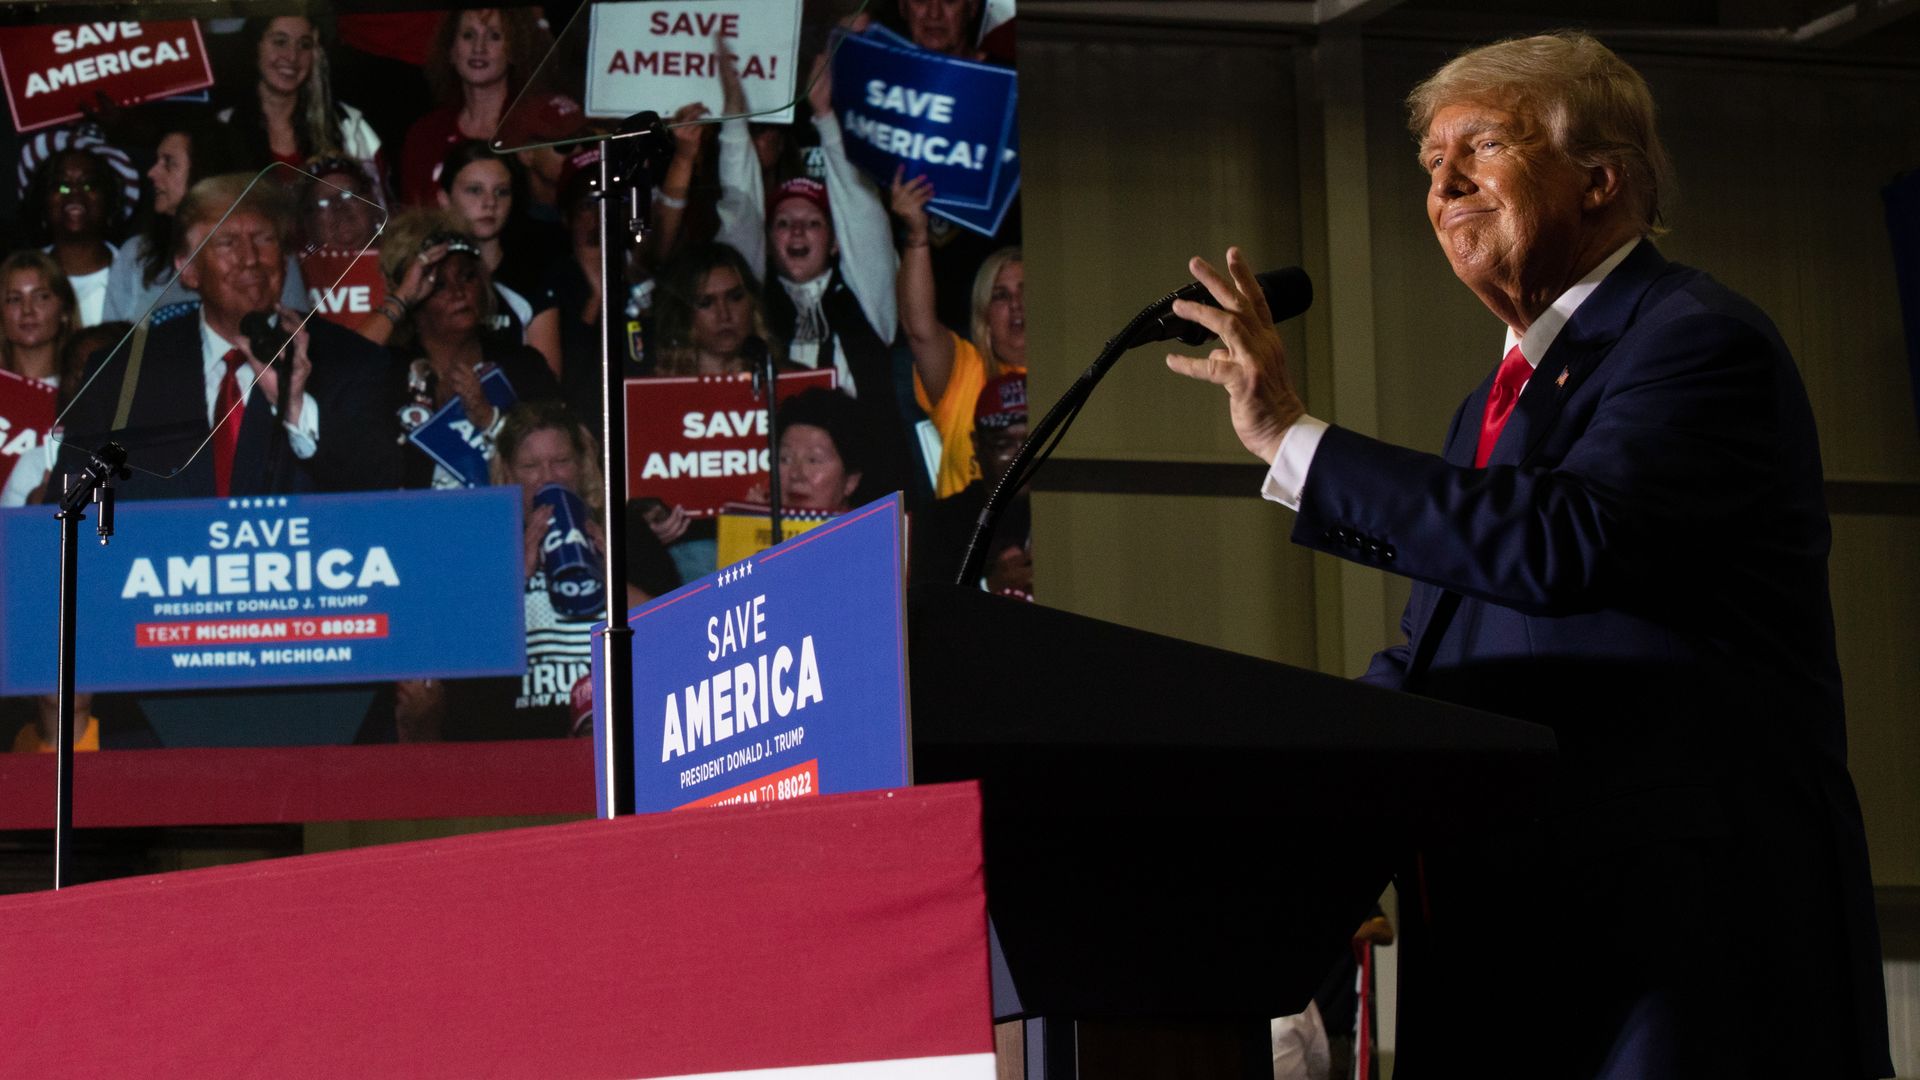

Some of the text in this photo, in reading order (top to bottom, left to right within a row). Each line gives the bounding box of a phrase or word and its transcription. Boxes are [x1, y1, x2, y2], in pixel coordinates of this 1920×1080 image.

[52, 21, 143, 54] SAVE
[650, 11, 740, 38] SAVE
[25, 37, 190, 98] AMERICA!
[866, 79, 955, 123] SAVE
[309, 286, 371, 314] AVE
[209, 517, 310, 549] SAVE
[121, 546, 400, 599] AMERICA
[153, 594, 369, 616] PRESIDENT DONALD J. TRUMP
[146, 618, 377, 642] TEXT MICHIGAN TO 88022
[707, 594, 767, 662] SAVE
[171, 646, 353, 668] WARREN, MICHIGAN
[661, 635, 824, 763] AMERICA
[680, 726, 805, 790] PRESIDENT DONALD J. TRUMP
[760, 784, 775, 802] TO
[777, 771, 812, 801] 88022
